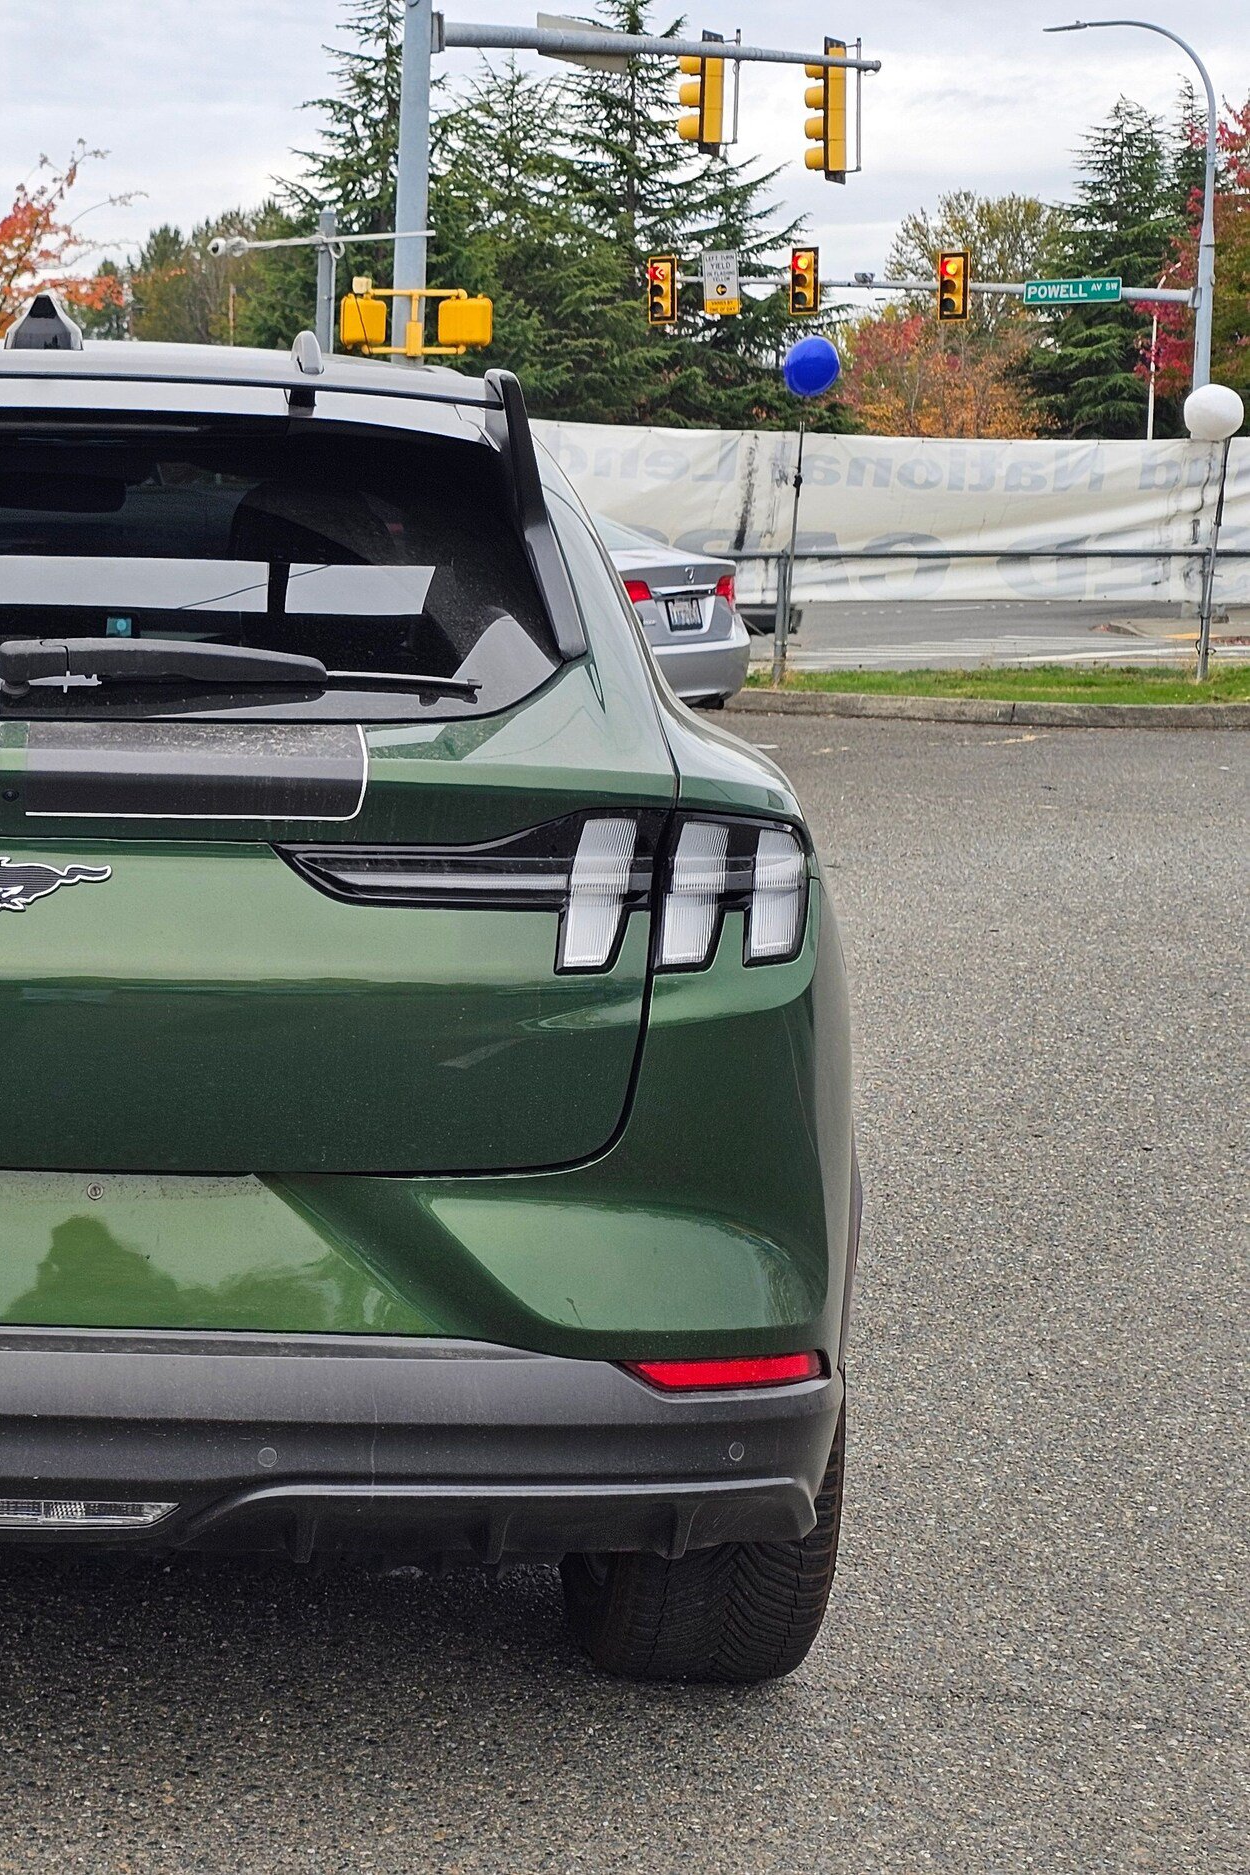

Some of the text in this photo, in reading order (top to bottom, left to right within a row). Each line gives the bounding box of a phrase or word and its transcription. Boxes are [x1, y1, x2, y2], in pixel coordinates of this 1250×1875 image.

[711, 262, 731, 270] YIELD
[1027, 282, 1118, 299] POWELL AV SW
